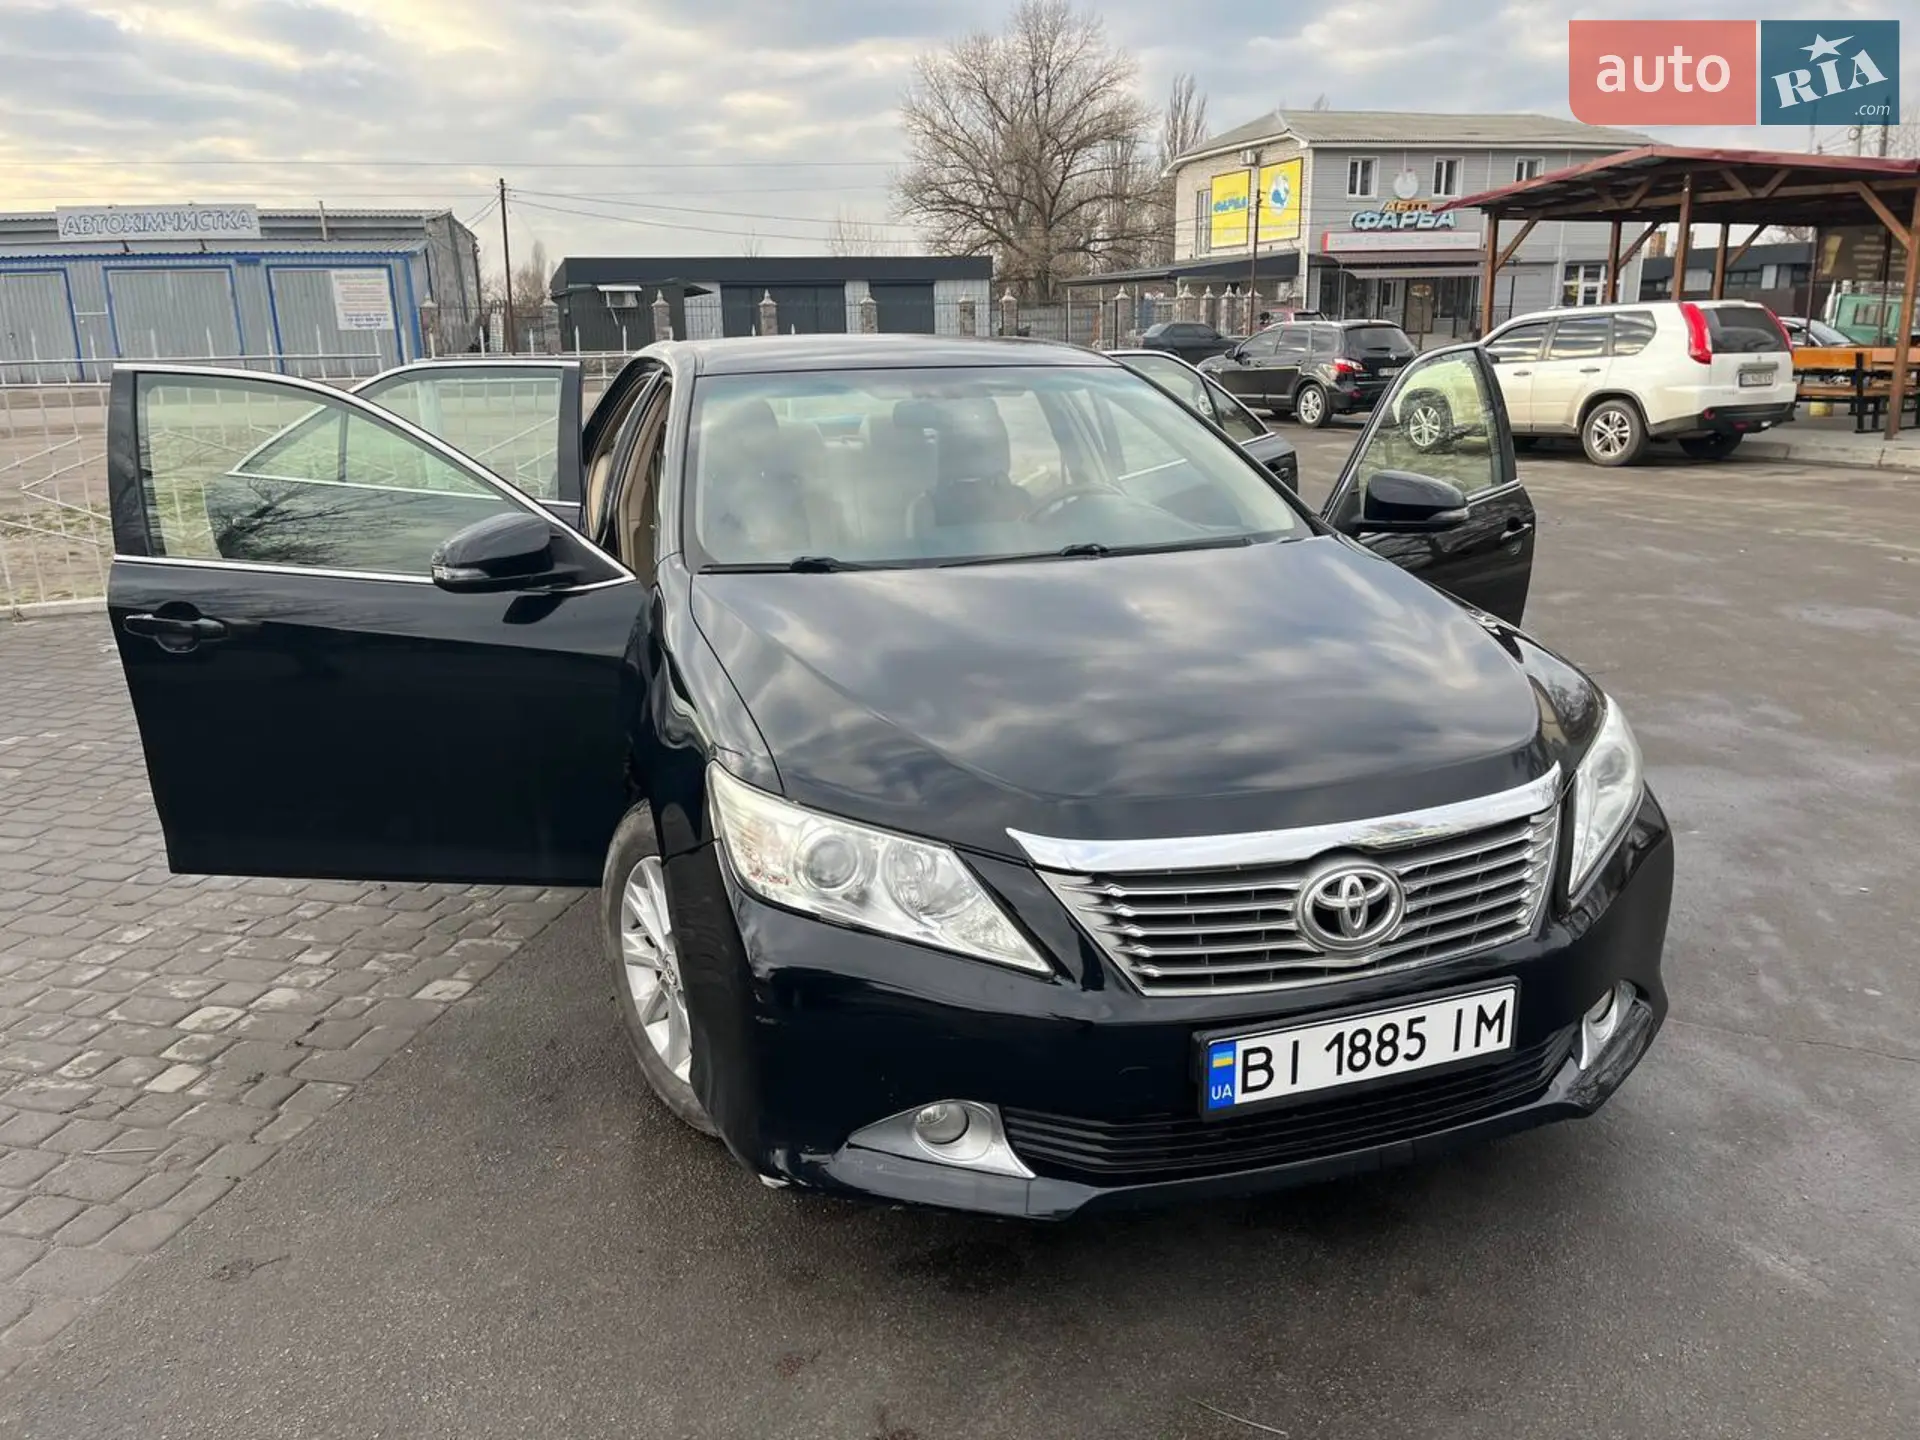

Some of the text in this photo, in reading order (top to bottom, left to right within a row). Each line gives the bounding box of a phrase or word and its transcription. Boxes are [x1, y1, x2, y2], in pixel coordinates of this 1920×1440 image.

[62, 209, 252, 236] АВТОХІМЧИСТКА
[1353, 210, 1456, 230] ФАРБА
[1241, 999, 1507, 1094] BI 1885 IM
[1211, 1084, 1233, 1100] UA
